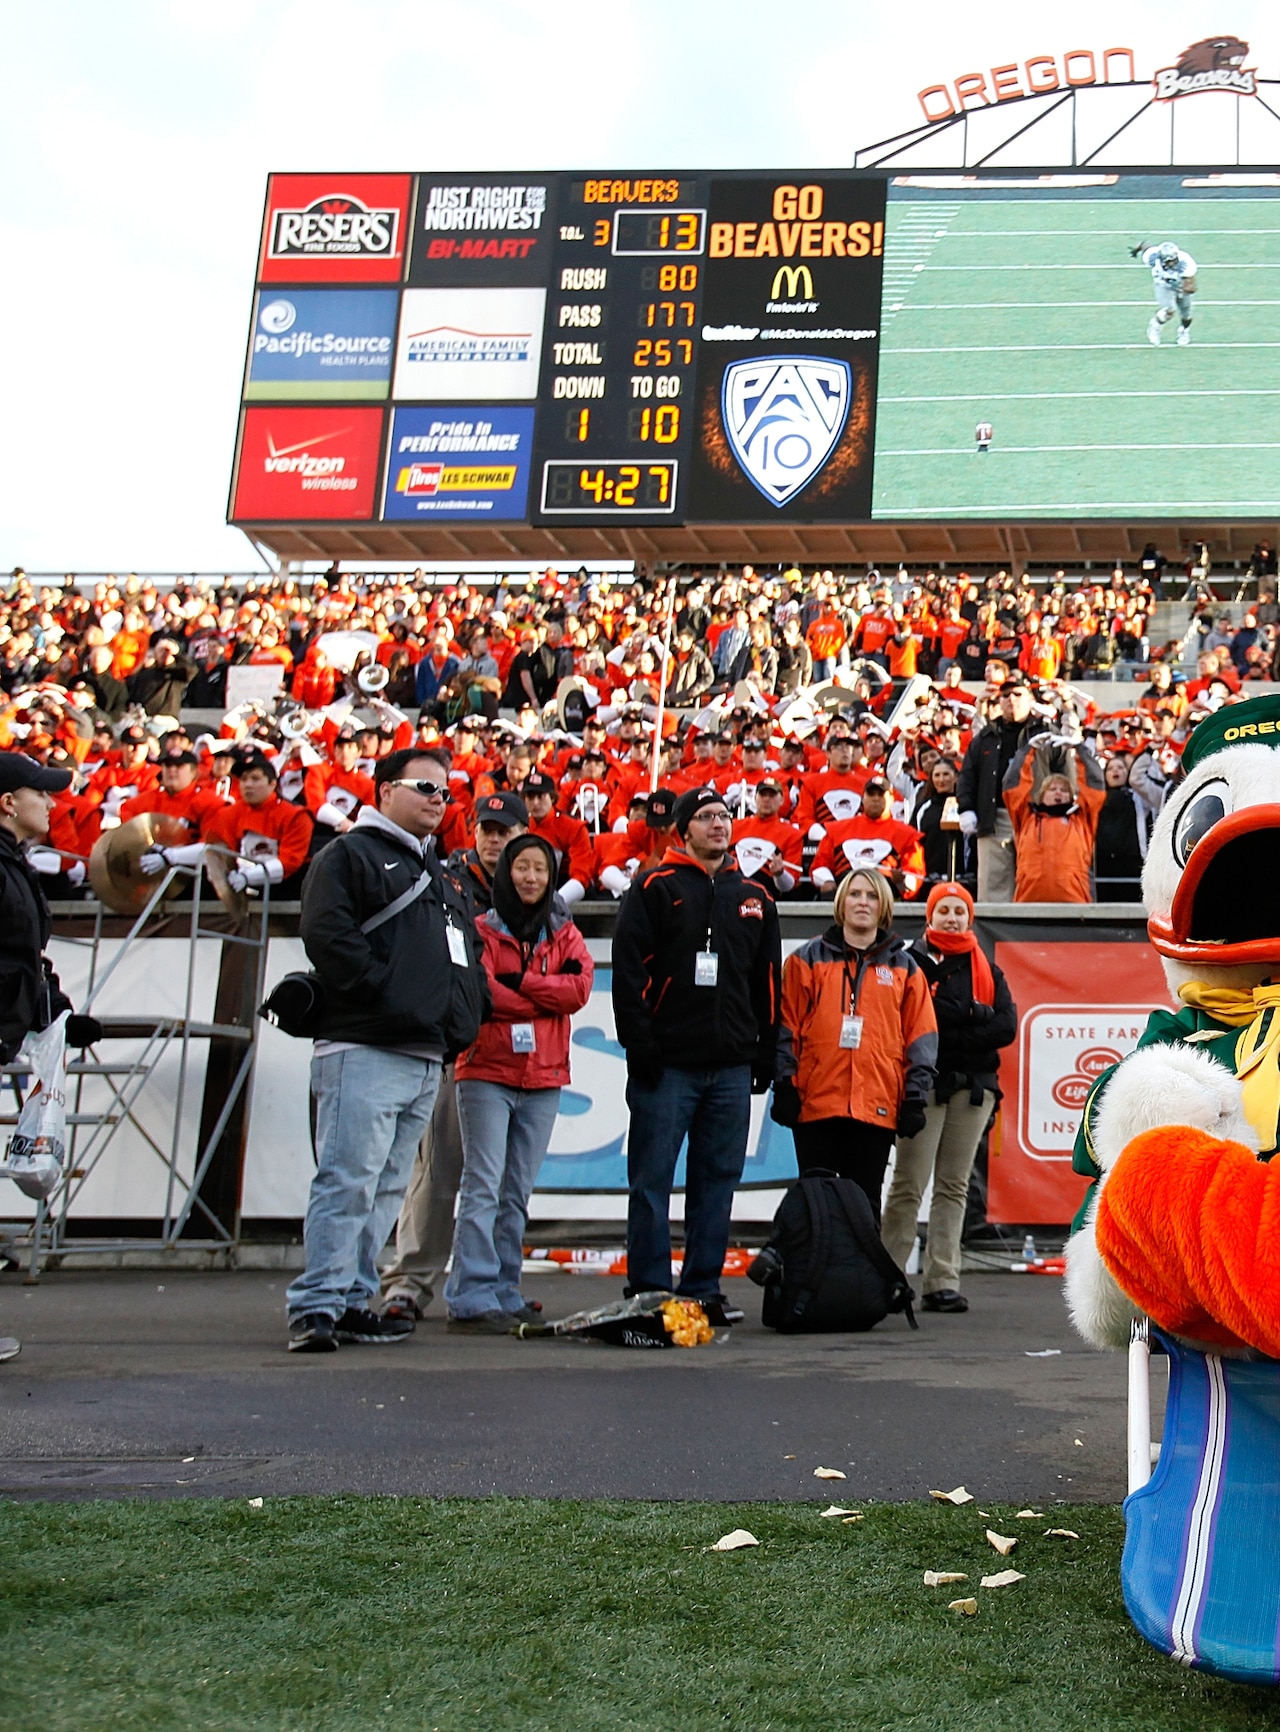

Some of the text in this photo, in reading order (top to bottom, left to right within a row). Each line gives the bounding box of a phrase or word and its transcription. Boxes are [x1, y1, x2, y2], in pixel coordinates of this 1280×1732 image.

[918, 48, 1135, 122] OREGON
[427, 187, 526, 208] JUST RIGHT
[584, 179, 680, 203] BEAVERS
[772, 185, 824, 221] GO
[425, 208, 545, 230] NORTHWEST
[593, 219, 611, 247] 3
[658, 214, 699, 250] 13
[709, 222, 883, 258] BEAVERS!
[561, 268, 606, 290] RUSH
[659, 265, 698, 291] 80
[559, 306, 602, 327] PASS
[646, 302, 696, 327] 177
[254, 332, 391, 358] PacificSource
[409, 341, 529, 351] AMERICAN FAMILY
[553, 342, 602, 365] TOTAL
[633, 340, 693, 366] 257
[320, 356, 355, 366] HEALTH
[554, 376, 606, 398] DOWN
[631, 376, 681, 398] TO GO
[578, 408, 589, 441] 1
[639, 405, 680, 443] 10
[399, 434, 520, 453] PERFORMANCE
[265, 453, 345, 476] verizon
[302, 476, 358, 490] wireless
[579, 466, 671, 506] 4:27
[1046, 1028, 1143, 1039] STATE FAR
